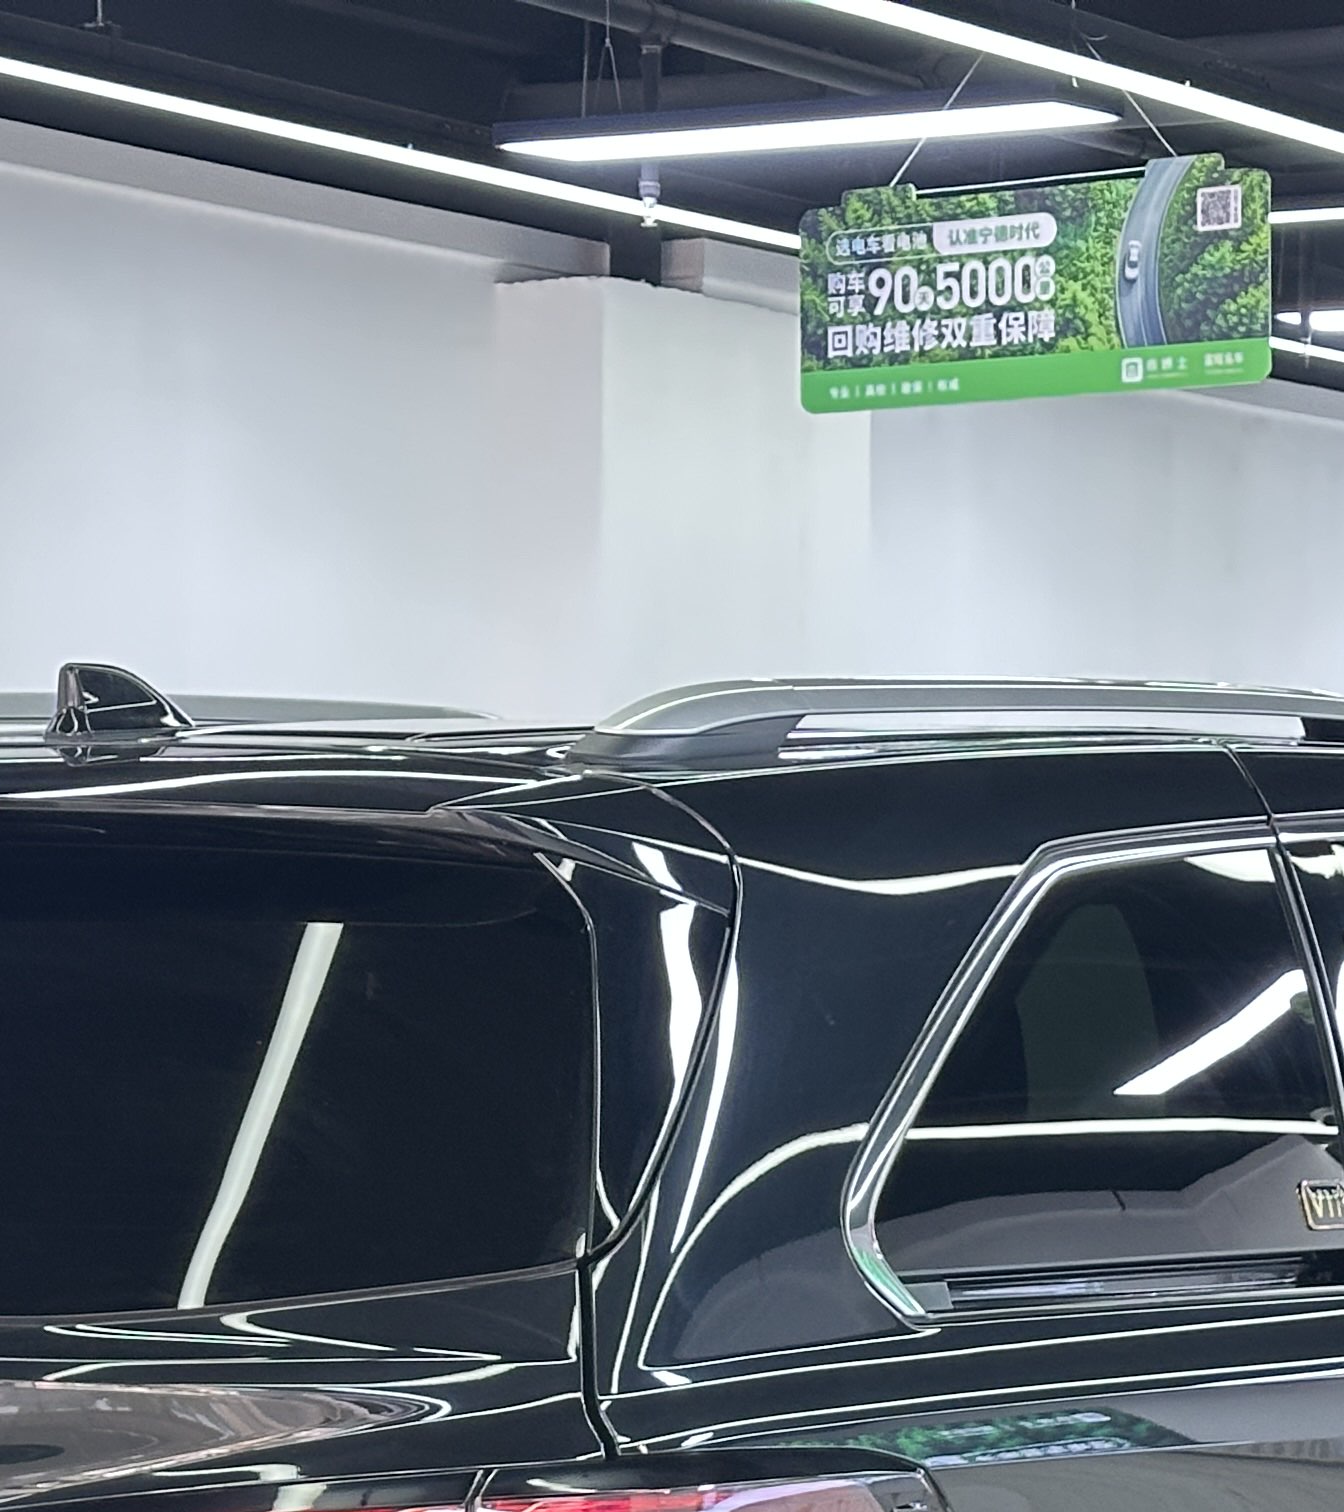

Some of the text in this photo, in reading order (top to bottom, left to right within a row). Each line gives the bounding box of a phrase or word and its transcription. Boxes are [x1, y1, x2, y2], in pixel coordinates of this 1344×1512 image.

[827, 308, 1056, 359] 回购维修双重保障
